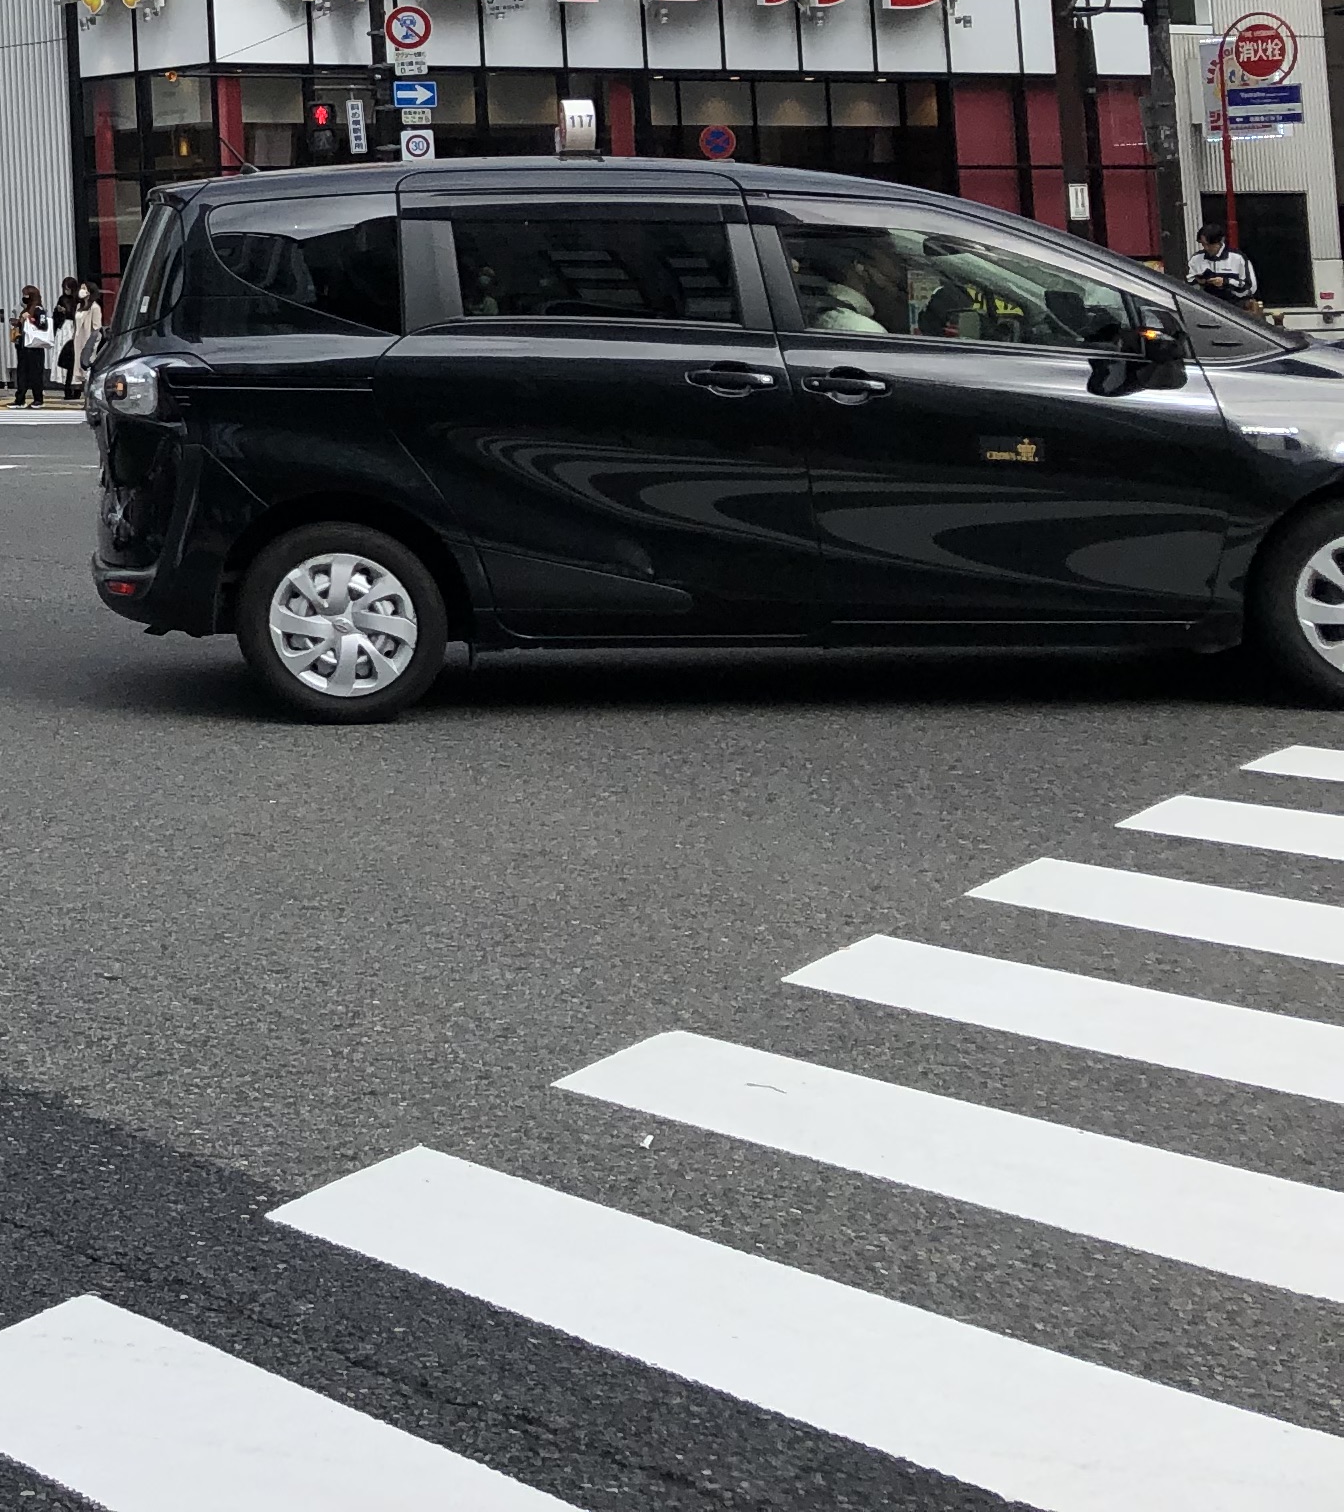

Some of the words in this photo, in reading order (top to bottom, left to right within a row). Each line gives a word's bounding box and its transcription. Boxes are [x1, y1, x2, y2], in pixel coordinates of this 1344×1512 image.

[1238, 38, 1283, 63] 消火栓
[570, 114, 594, 129] 117
[411, 140, 425, 151] 30
